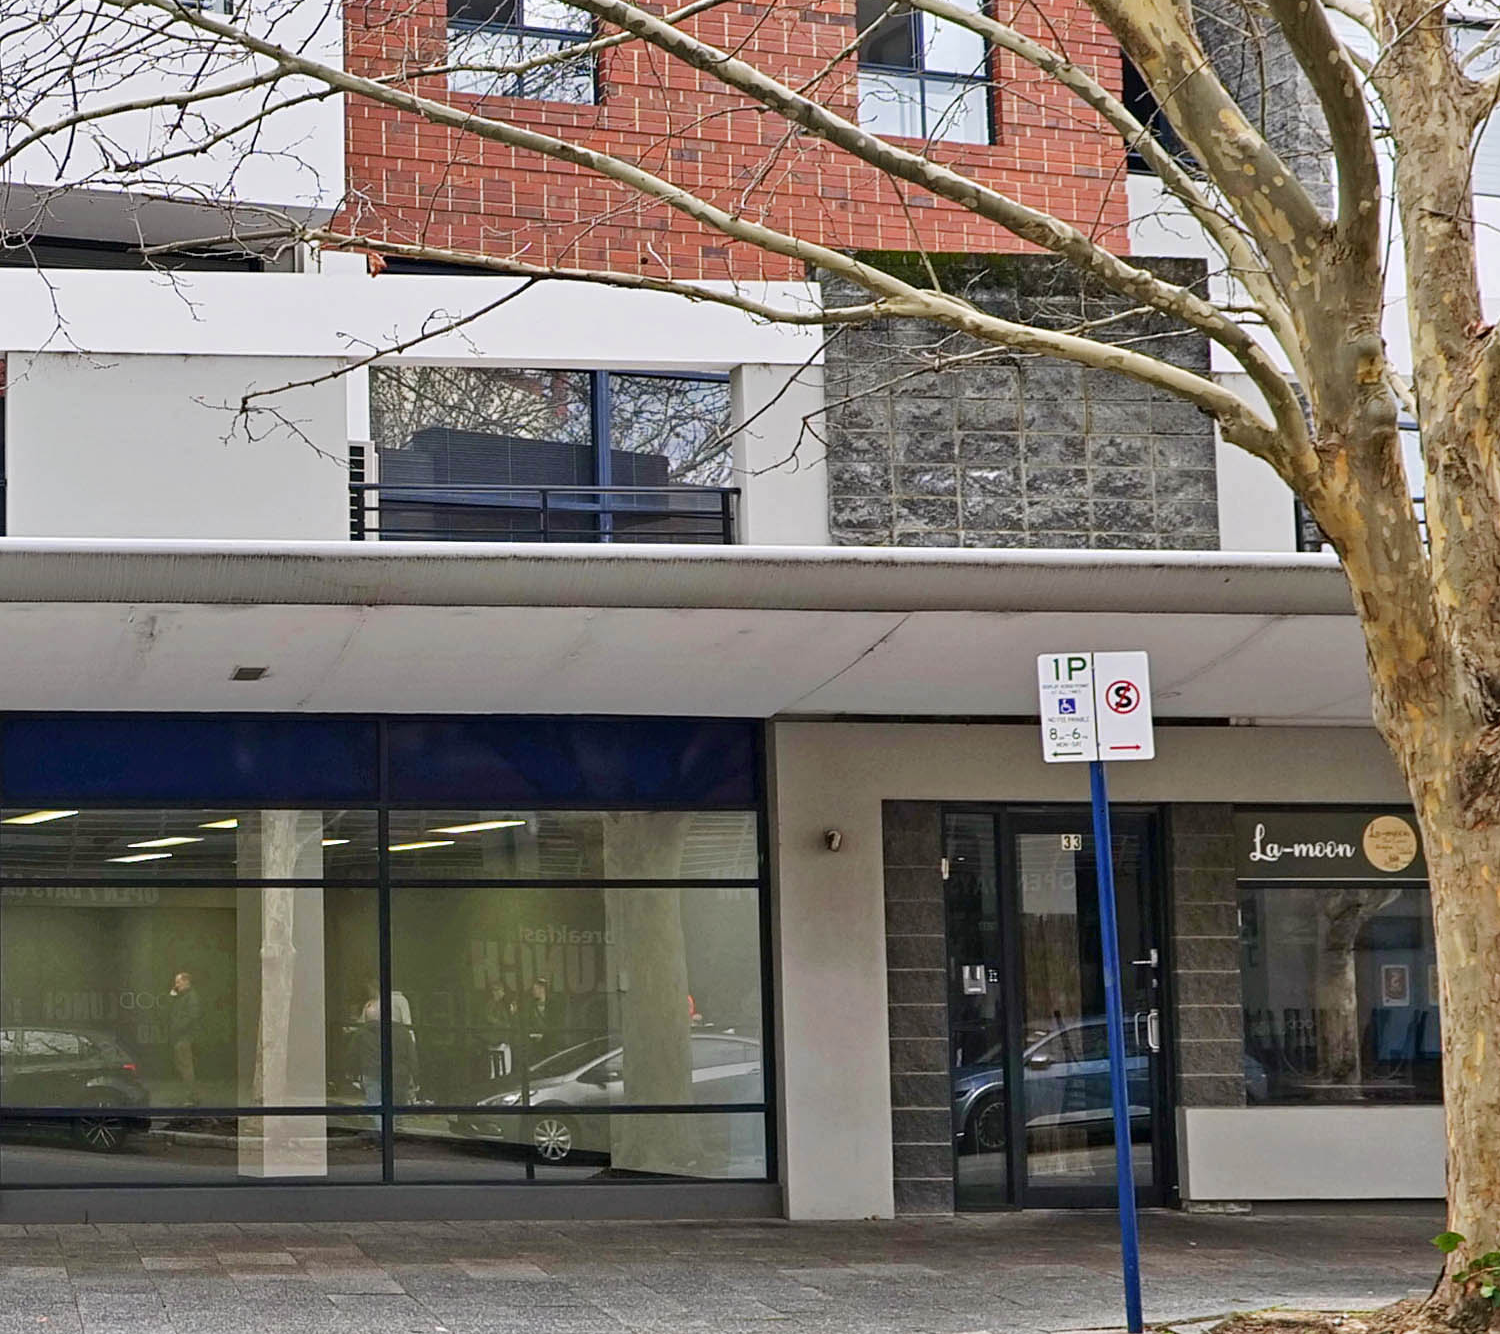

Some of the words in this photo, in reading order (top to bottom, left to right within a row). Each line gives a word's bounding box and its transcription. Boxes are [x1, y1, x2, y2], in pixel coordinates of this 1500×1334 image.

[1053, 657, 1087, 681] 1P
[1063, 835, 1080, 849] 33
[1249, 823, 1356, 862] La-moon
